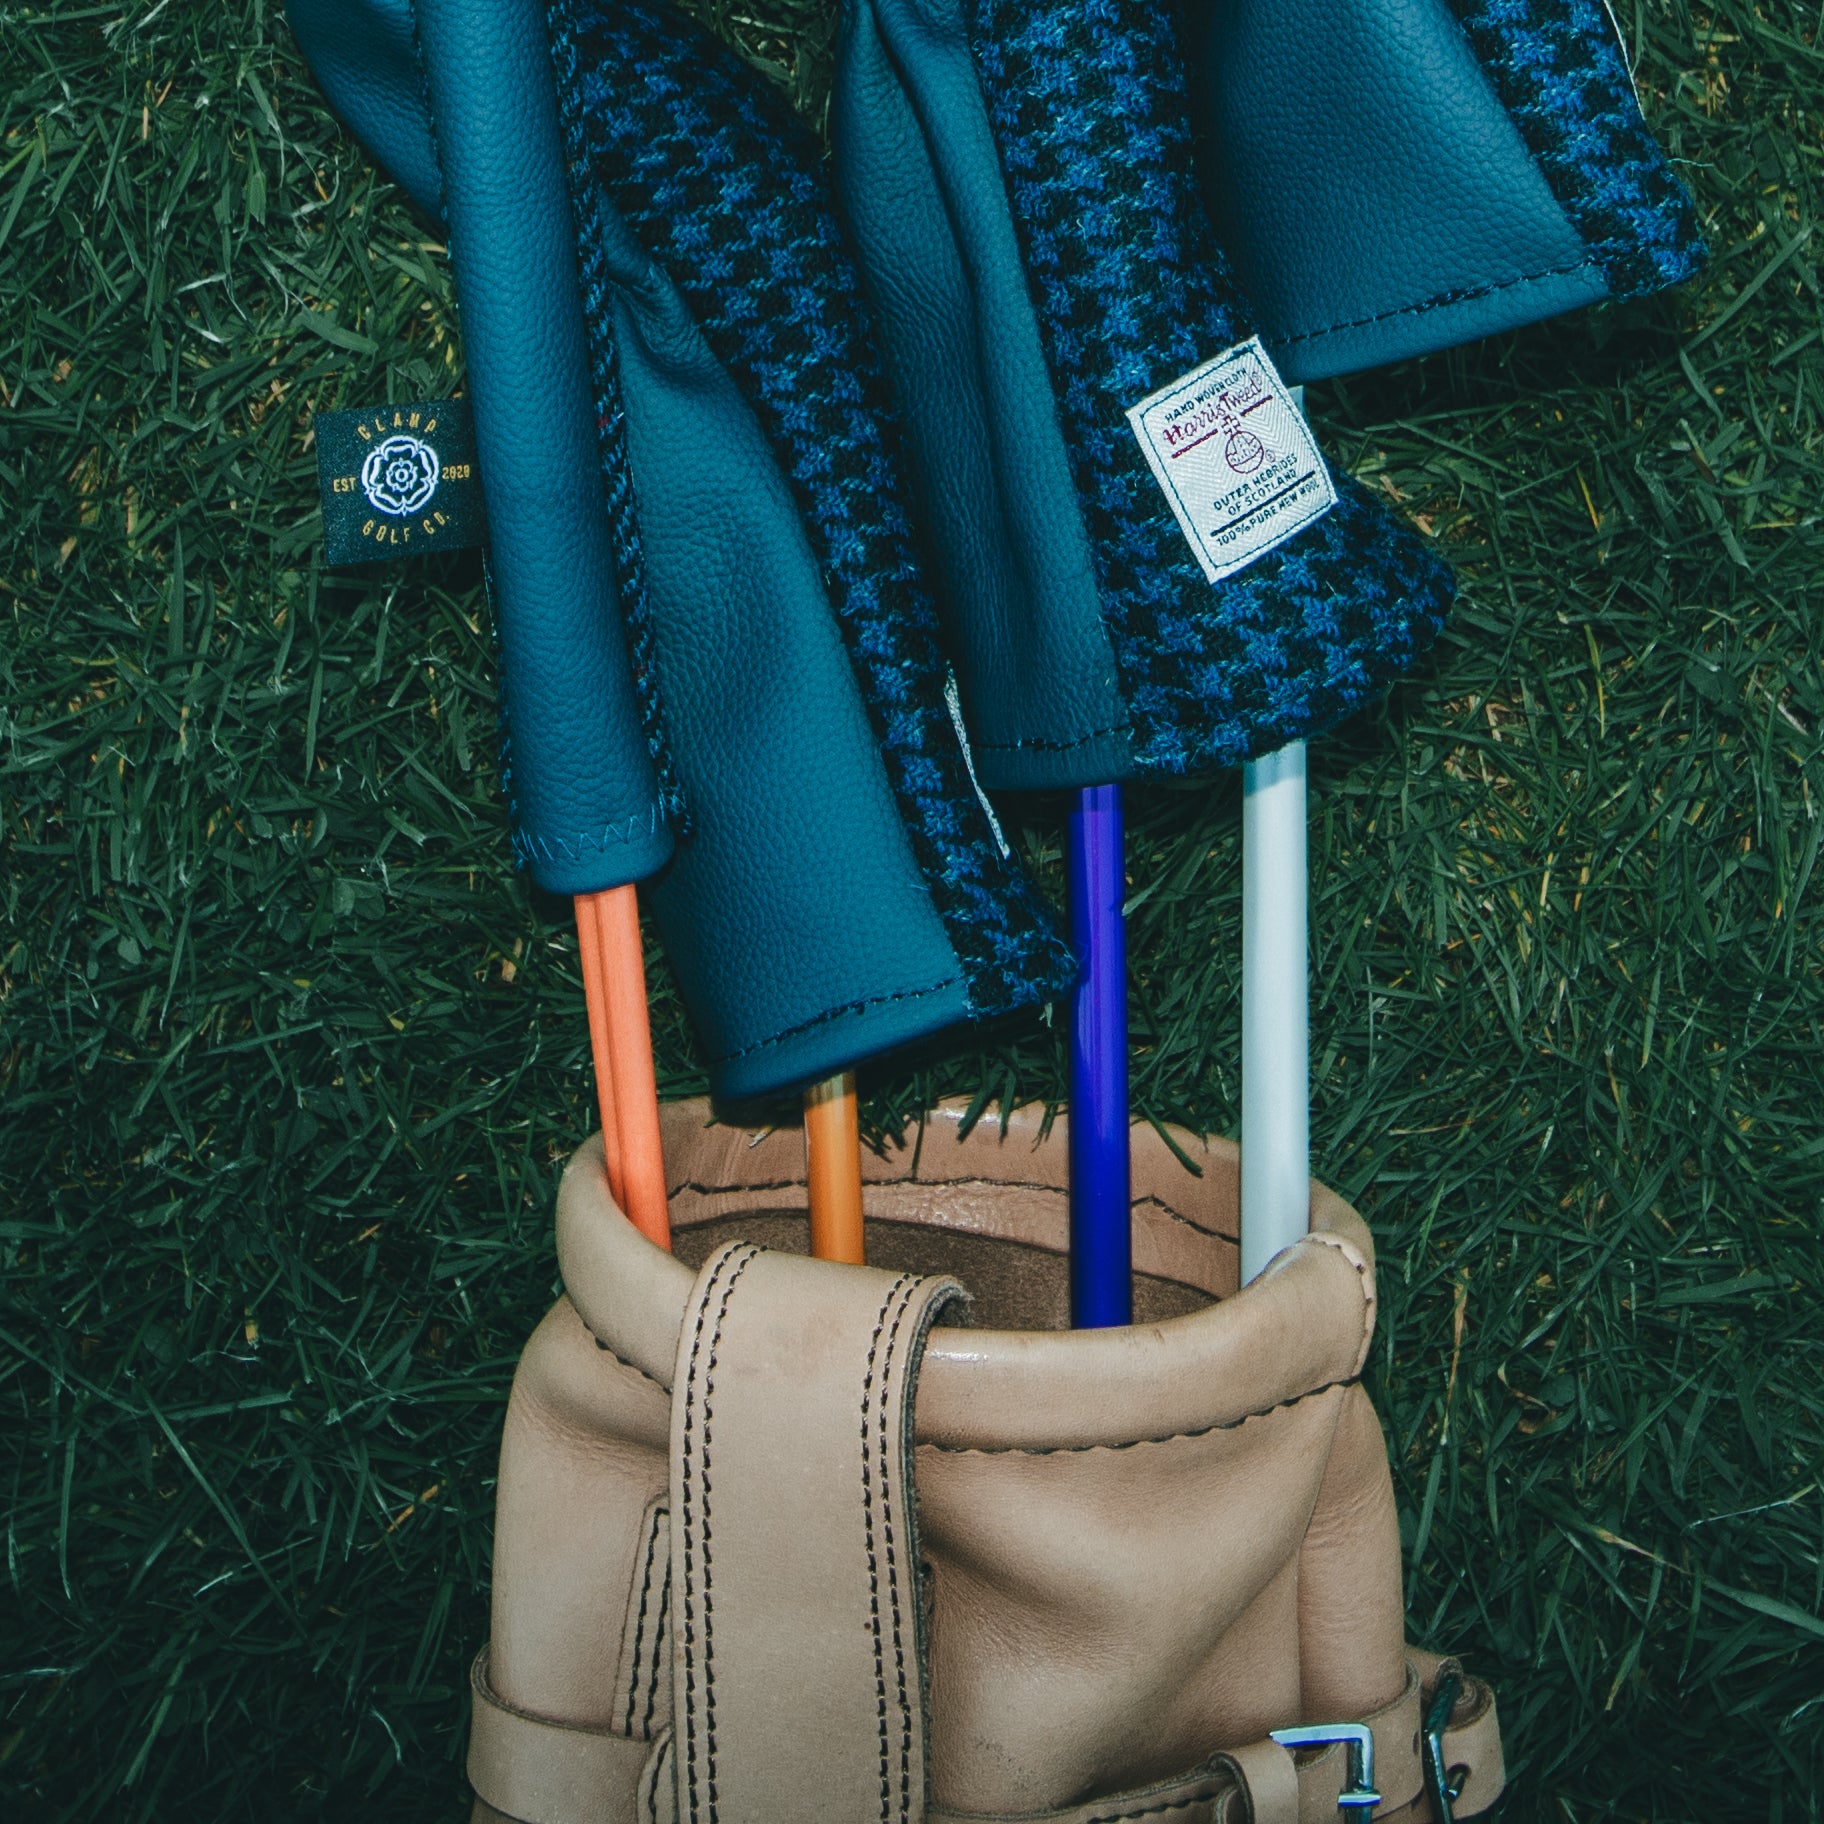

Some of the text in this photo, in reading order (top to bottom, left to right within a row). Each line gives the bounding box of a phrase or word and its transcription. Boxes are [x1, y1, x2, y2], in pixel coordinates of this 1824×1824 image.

[1164, 367, 1247, 423] HAND WOVEN CLOTH
[357, 412, 437, 440] CLAMP
[1163, 402, 1226, 445] Harris
[333, 464, 470, 493] EST 2020
[1213, 483, 1252, 511] OUTER
[1252, 452, 1298, 486] HEBRIDES
[1227, 468, 1297, 516] OF SCOTLAND
[1249, 505, 1279, 528] PURE
[1278, 492, 1298, 511] NEW
[362, 519, 410, 544] GOLF
